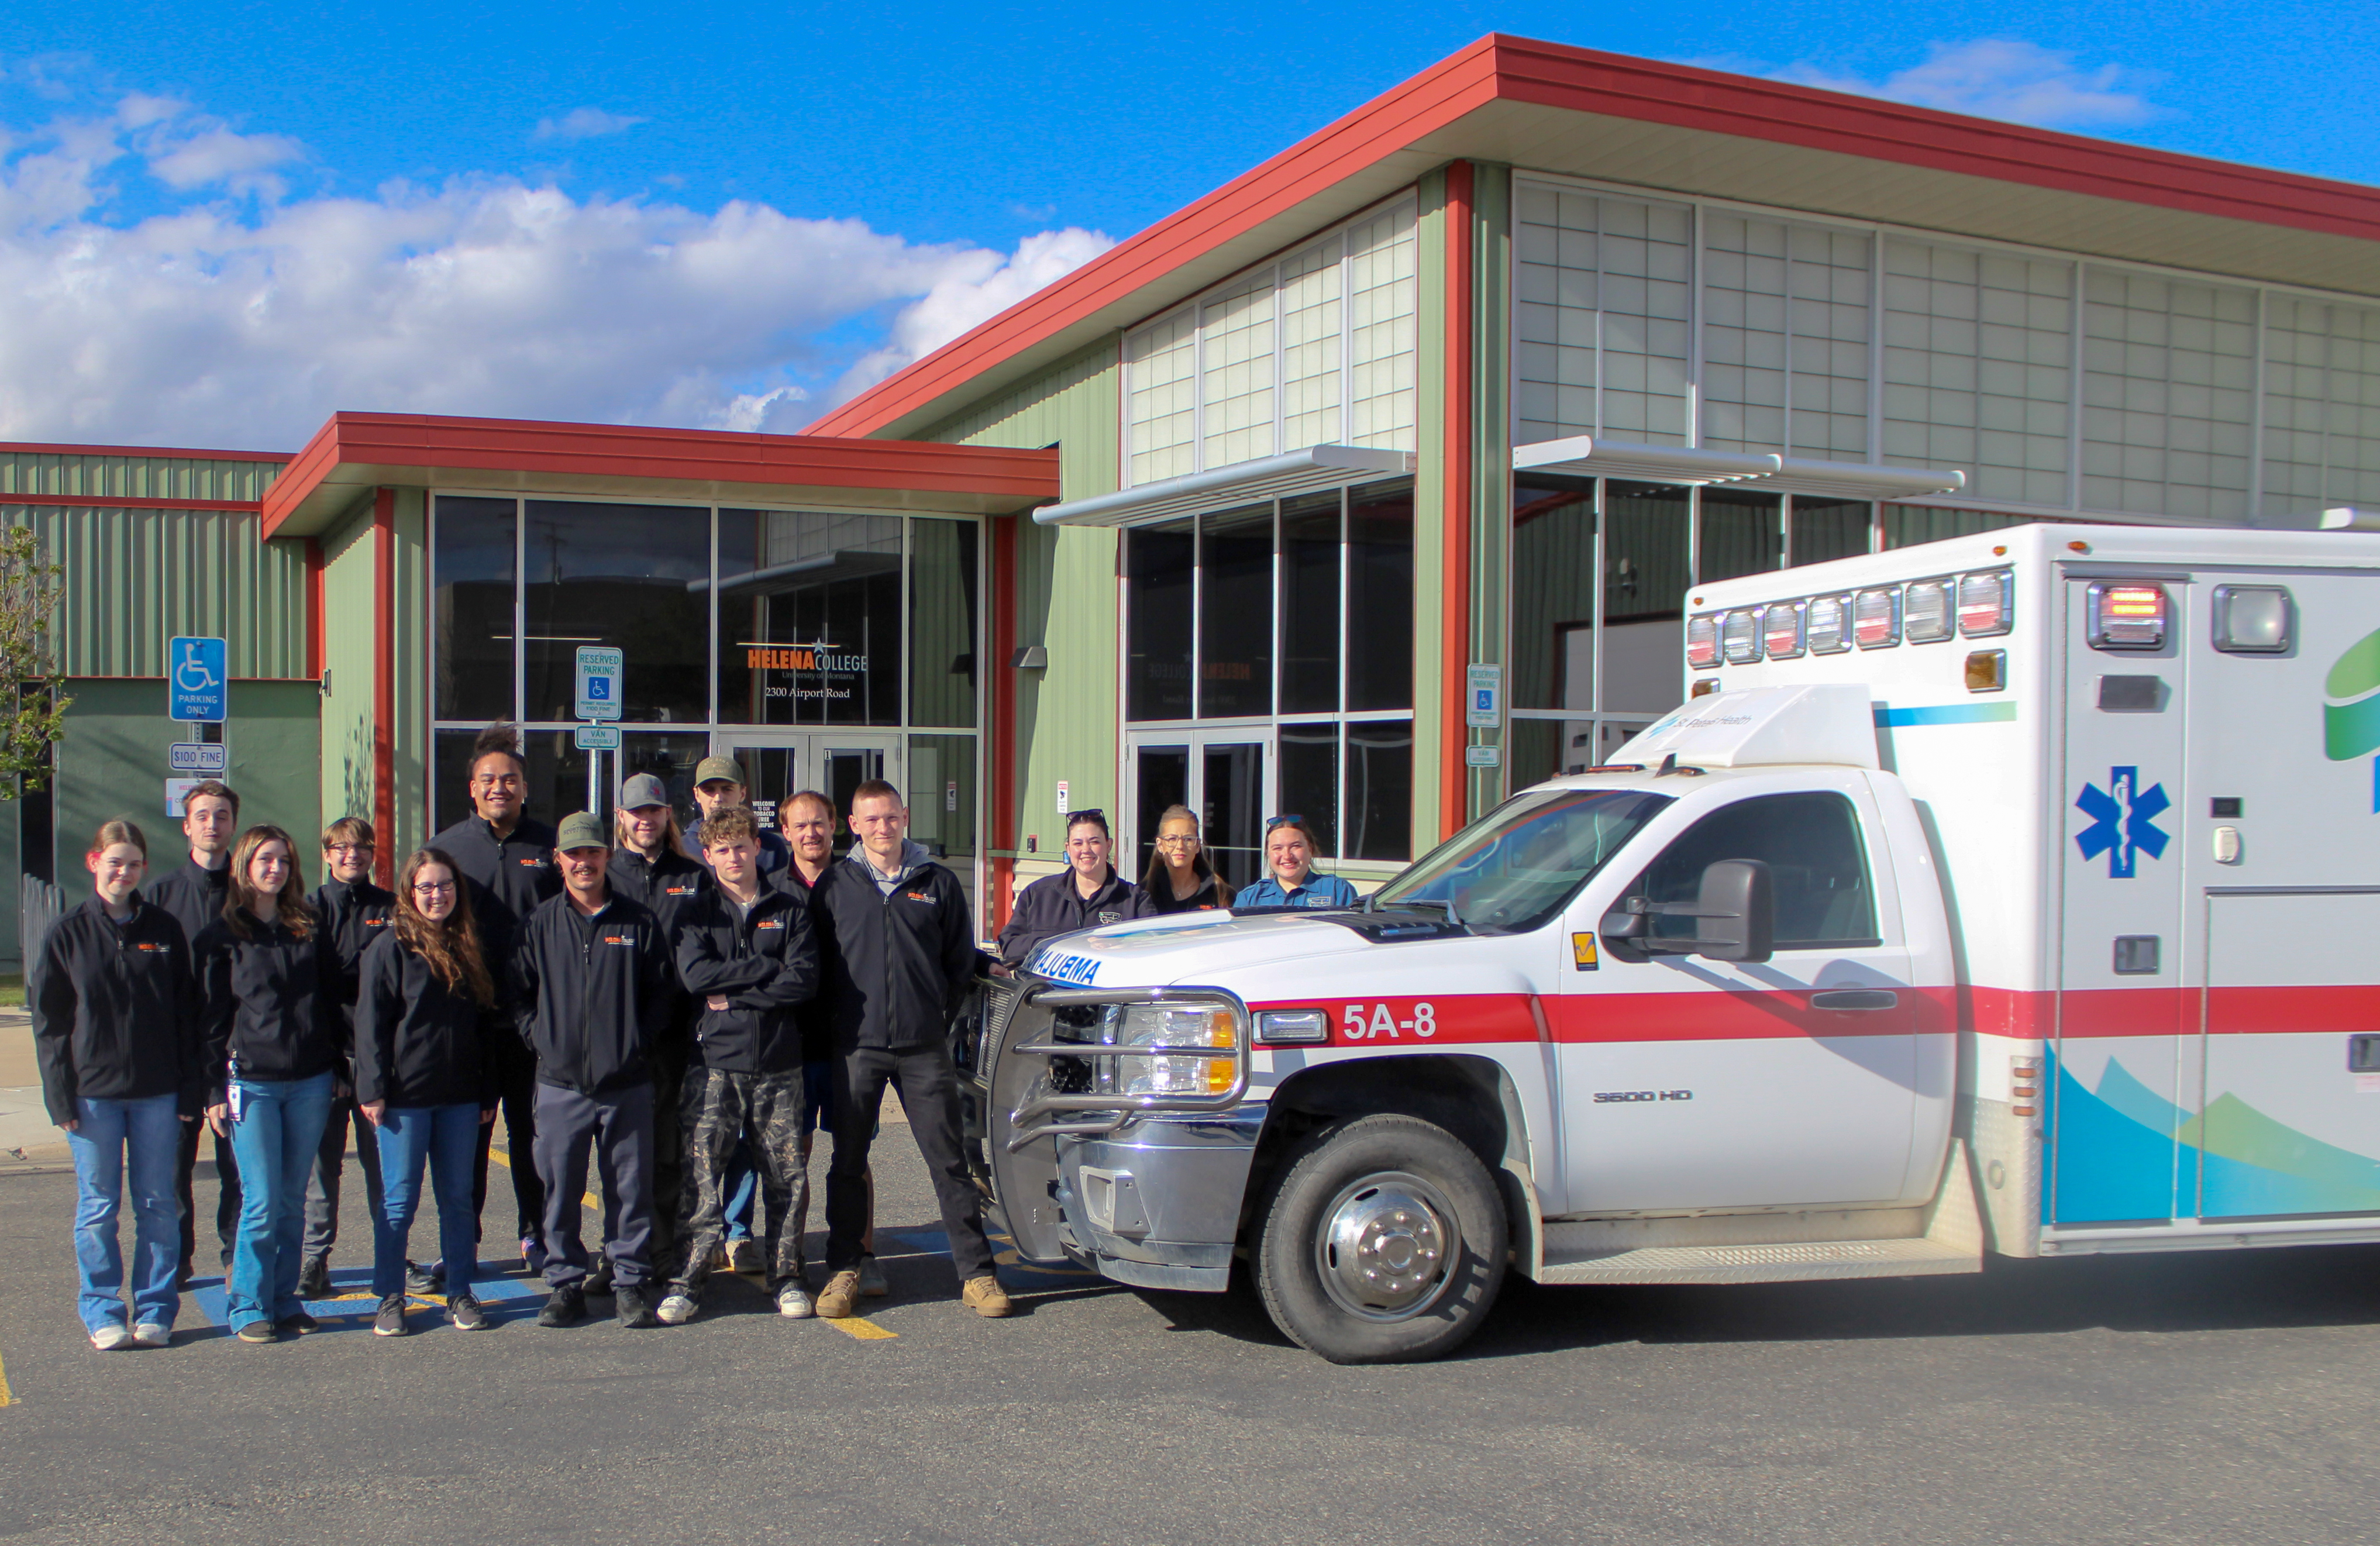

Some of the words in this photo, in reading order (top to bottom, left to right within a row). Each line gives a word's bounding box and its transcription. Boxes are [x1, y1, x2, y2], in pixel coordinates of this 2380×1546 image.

[580, 655, 619, 664] RESERVED
[748, 650, 815, 669] HELENA
[815, 655, 867, 671] COLLEGE
[584, 666, 614, 675] PARKING
[1470, 670, 1499, 679] RESERVED
[1473, 680, 1496, 688] PARKING
[766, 687, 787, 697] 2300
[789, 688, 824, 700] Airport
[826, 688, 850, 697] Road
[178, 695, 218, 704] PARKING
[174, 751, 196, 762] $100
[201, 752, 221, 762] FINE
[825, 751, 829, 759] 1
[1344, 1003, 1437, 1039] 5A-8
[1593, 1091, 1656, 1103] 3500
[1659, 1089, 1693, 1101] HD
